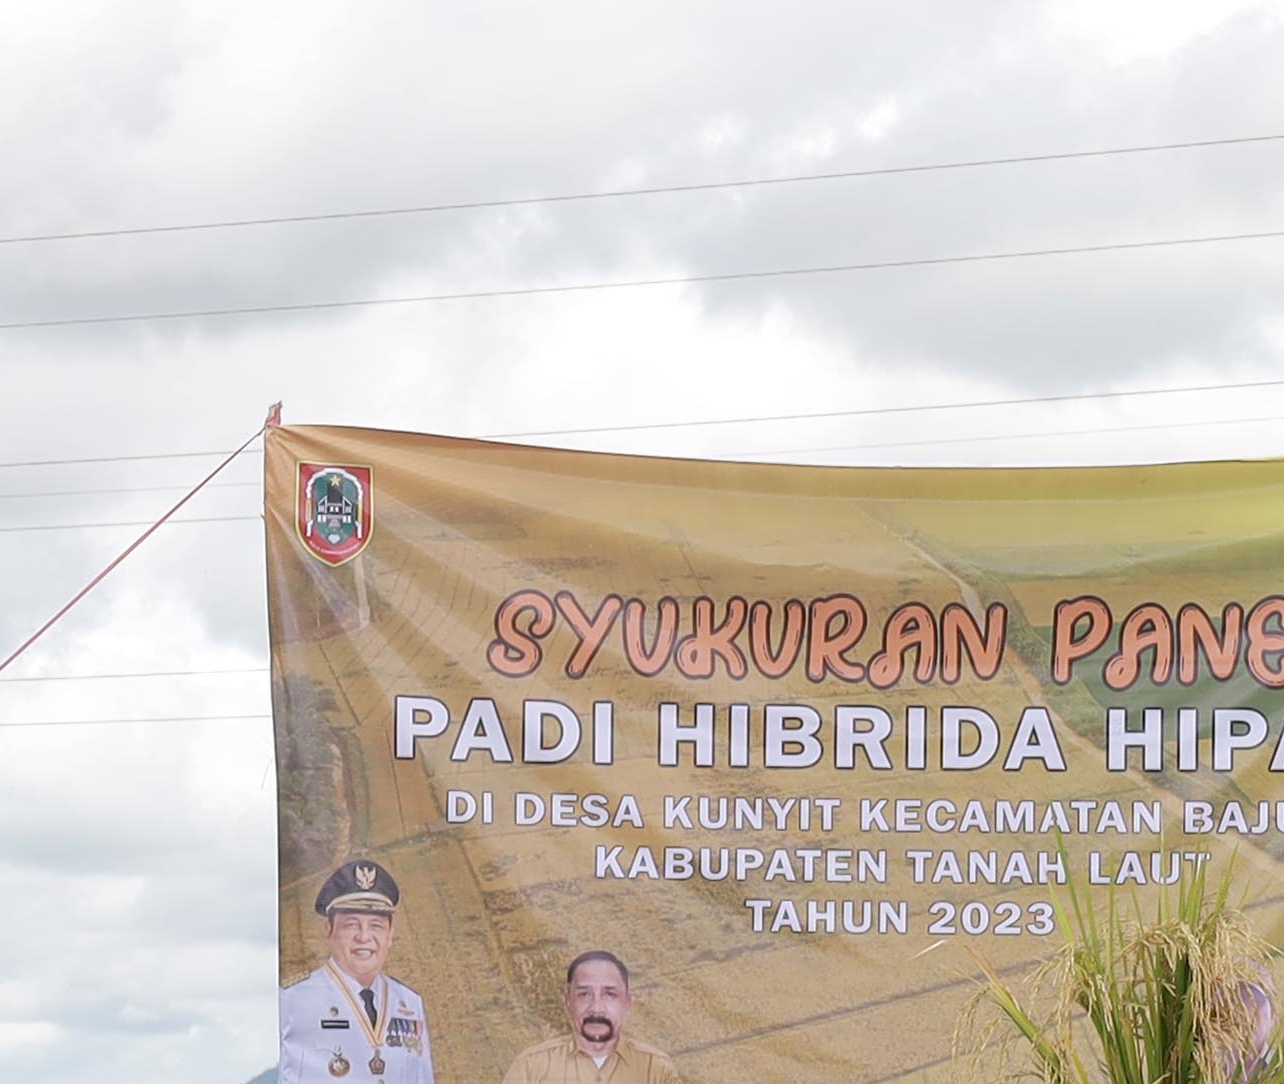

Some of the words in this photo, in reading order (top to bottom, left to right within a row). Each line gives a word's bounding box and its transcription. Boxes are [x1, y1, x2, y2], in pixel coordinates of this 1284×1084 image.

[488, 591, 1007, 689] SYUKURAN
[394, 696, 614, 766] PADI
[658, 703, 1067, 772] HIBRIDA
[446, 791, 494, 825] DI
[515, 794, 644, 829] DESA
[664, 797, 842, 832] KUNYIT
[860, 798, 1163, 835] KECAMATAN
[594, 846, 888, 883] KABUPATEN
[907, 850, 1066, 885] TANAH
[1088, 850, 1212, 886] LAUT
[745, 900, 909, 933] TAHUN
[927, 901, 1057, 936] 2023
